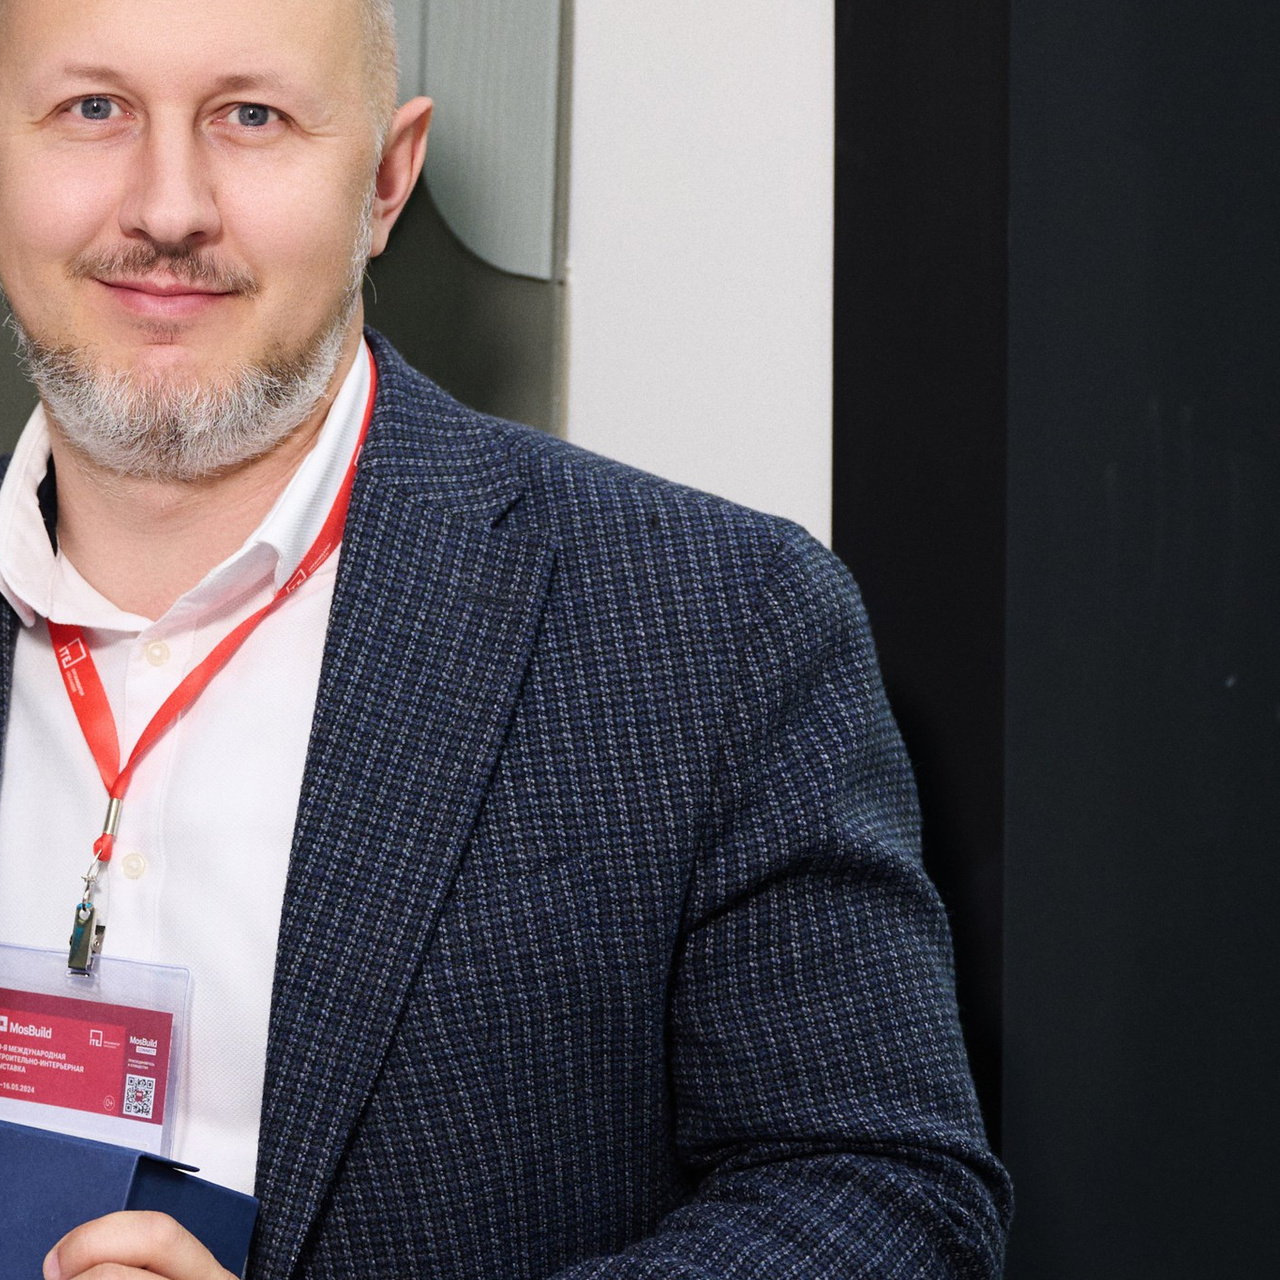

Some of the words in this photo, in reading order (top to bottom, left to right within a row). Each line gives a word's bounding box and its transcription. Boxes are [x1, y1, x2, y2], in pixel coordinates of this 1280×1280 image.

[9, 1021, 52, 1039] MosBuild
[129, 1035, 158, 1048] MosBuild
[8, 1044, 67, 1060] МЕЖДУНАРОДНАЯ
